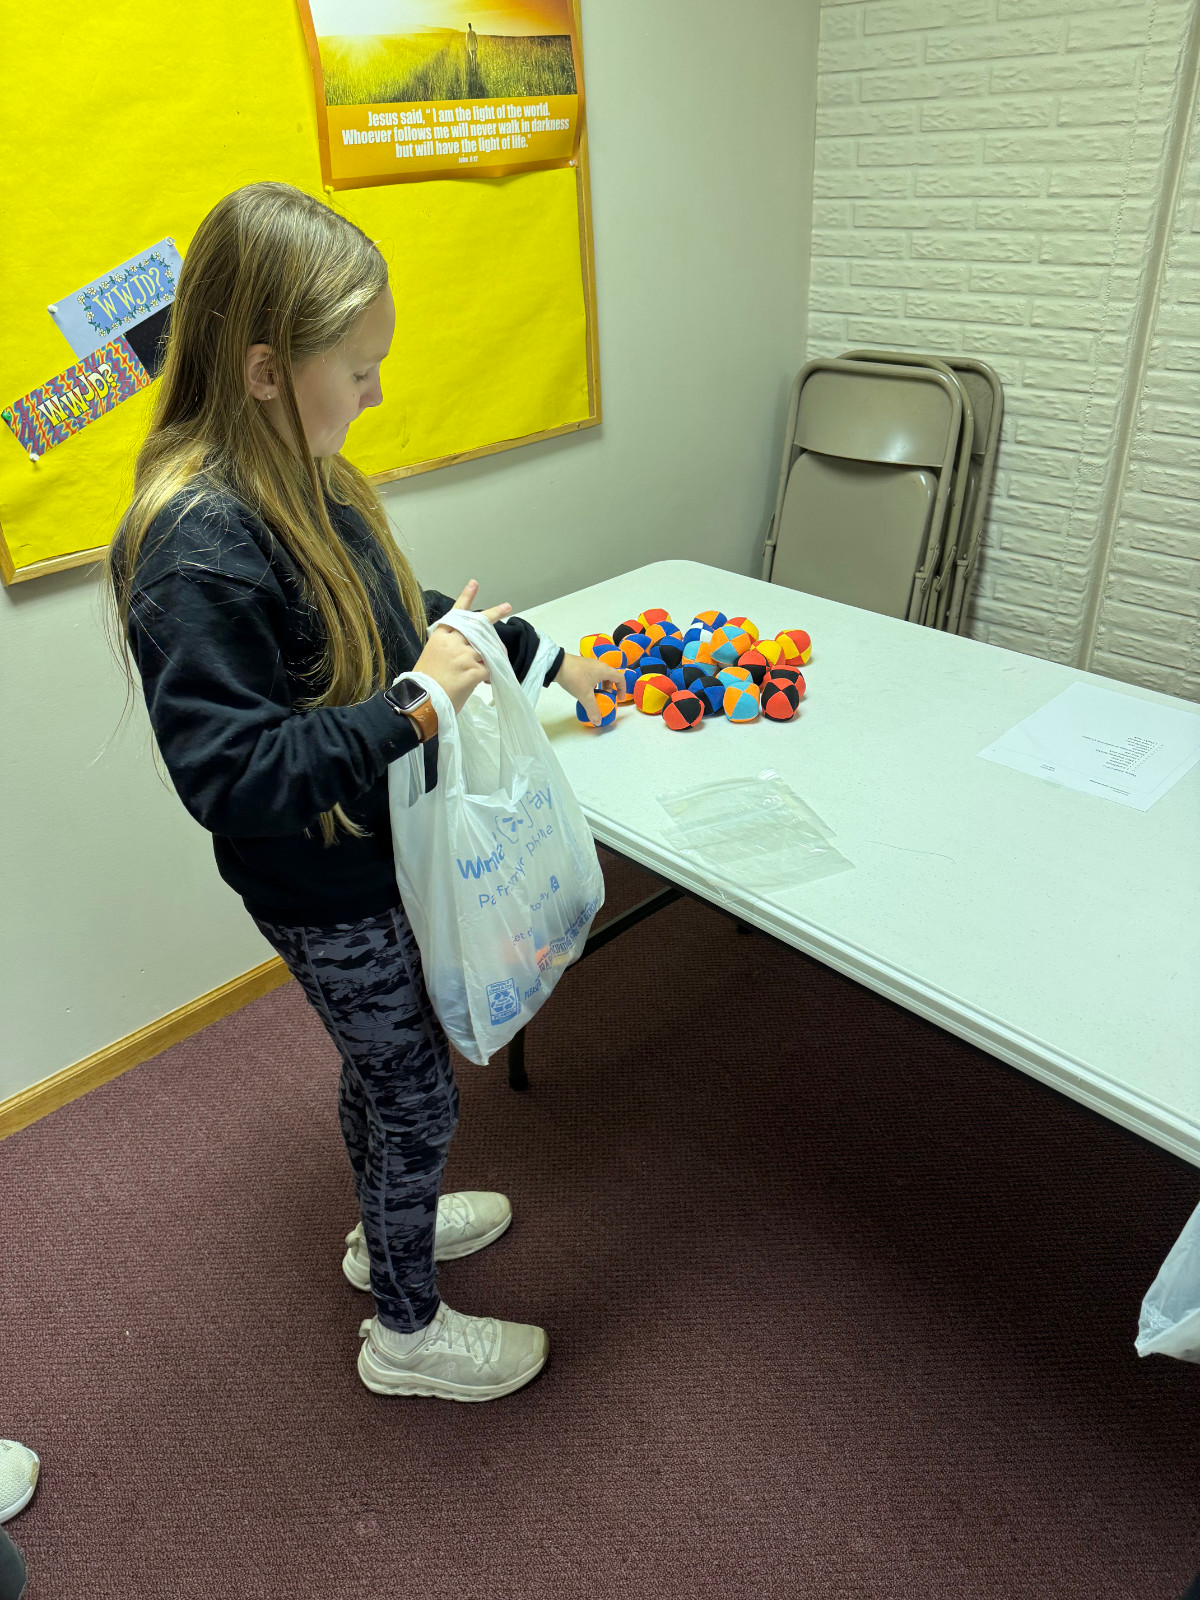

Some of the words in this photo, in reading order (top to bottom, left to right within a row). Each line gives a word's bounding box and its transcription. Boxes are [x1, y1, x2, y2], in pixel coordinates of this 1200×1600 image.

[368, 111, 398, 127] Jesus
[400, 109, 425, 125] said,
[438, 109, 455, 123] am
[455, 106, 471, 122] the
[472, 105, 495, 122] light
[496, 104, 506, 119] of
[506, 104, 522, 118] the
[523, 102, 551, 117] world.
[341, 129, 392, 145] Whoever
[393, 126, 432, 142] follows
[433, 126, 450, 139] me
[450, 122, 469, 138] will
[470, 123, 497, 137] never
[498, 119, 520, 134] walk
[521, 119, 530, 133] in
[531, 118, 570, 132] darkness
[395, 143, 413, 158] but
[414, 141, 434, 156] will
[435, 140, 460, 155] have
[460, 138, 477, 153] the
[478, 136, 500, 153] light
[501, 135, 511, 150] of
[92, 267, 165, 321] WWJD?
[37, 363, 118, 427] WWJD?
